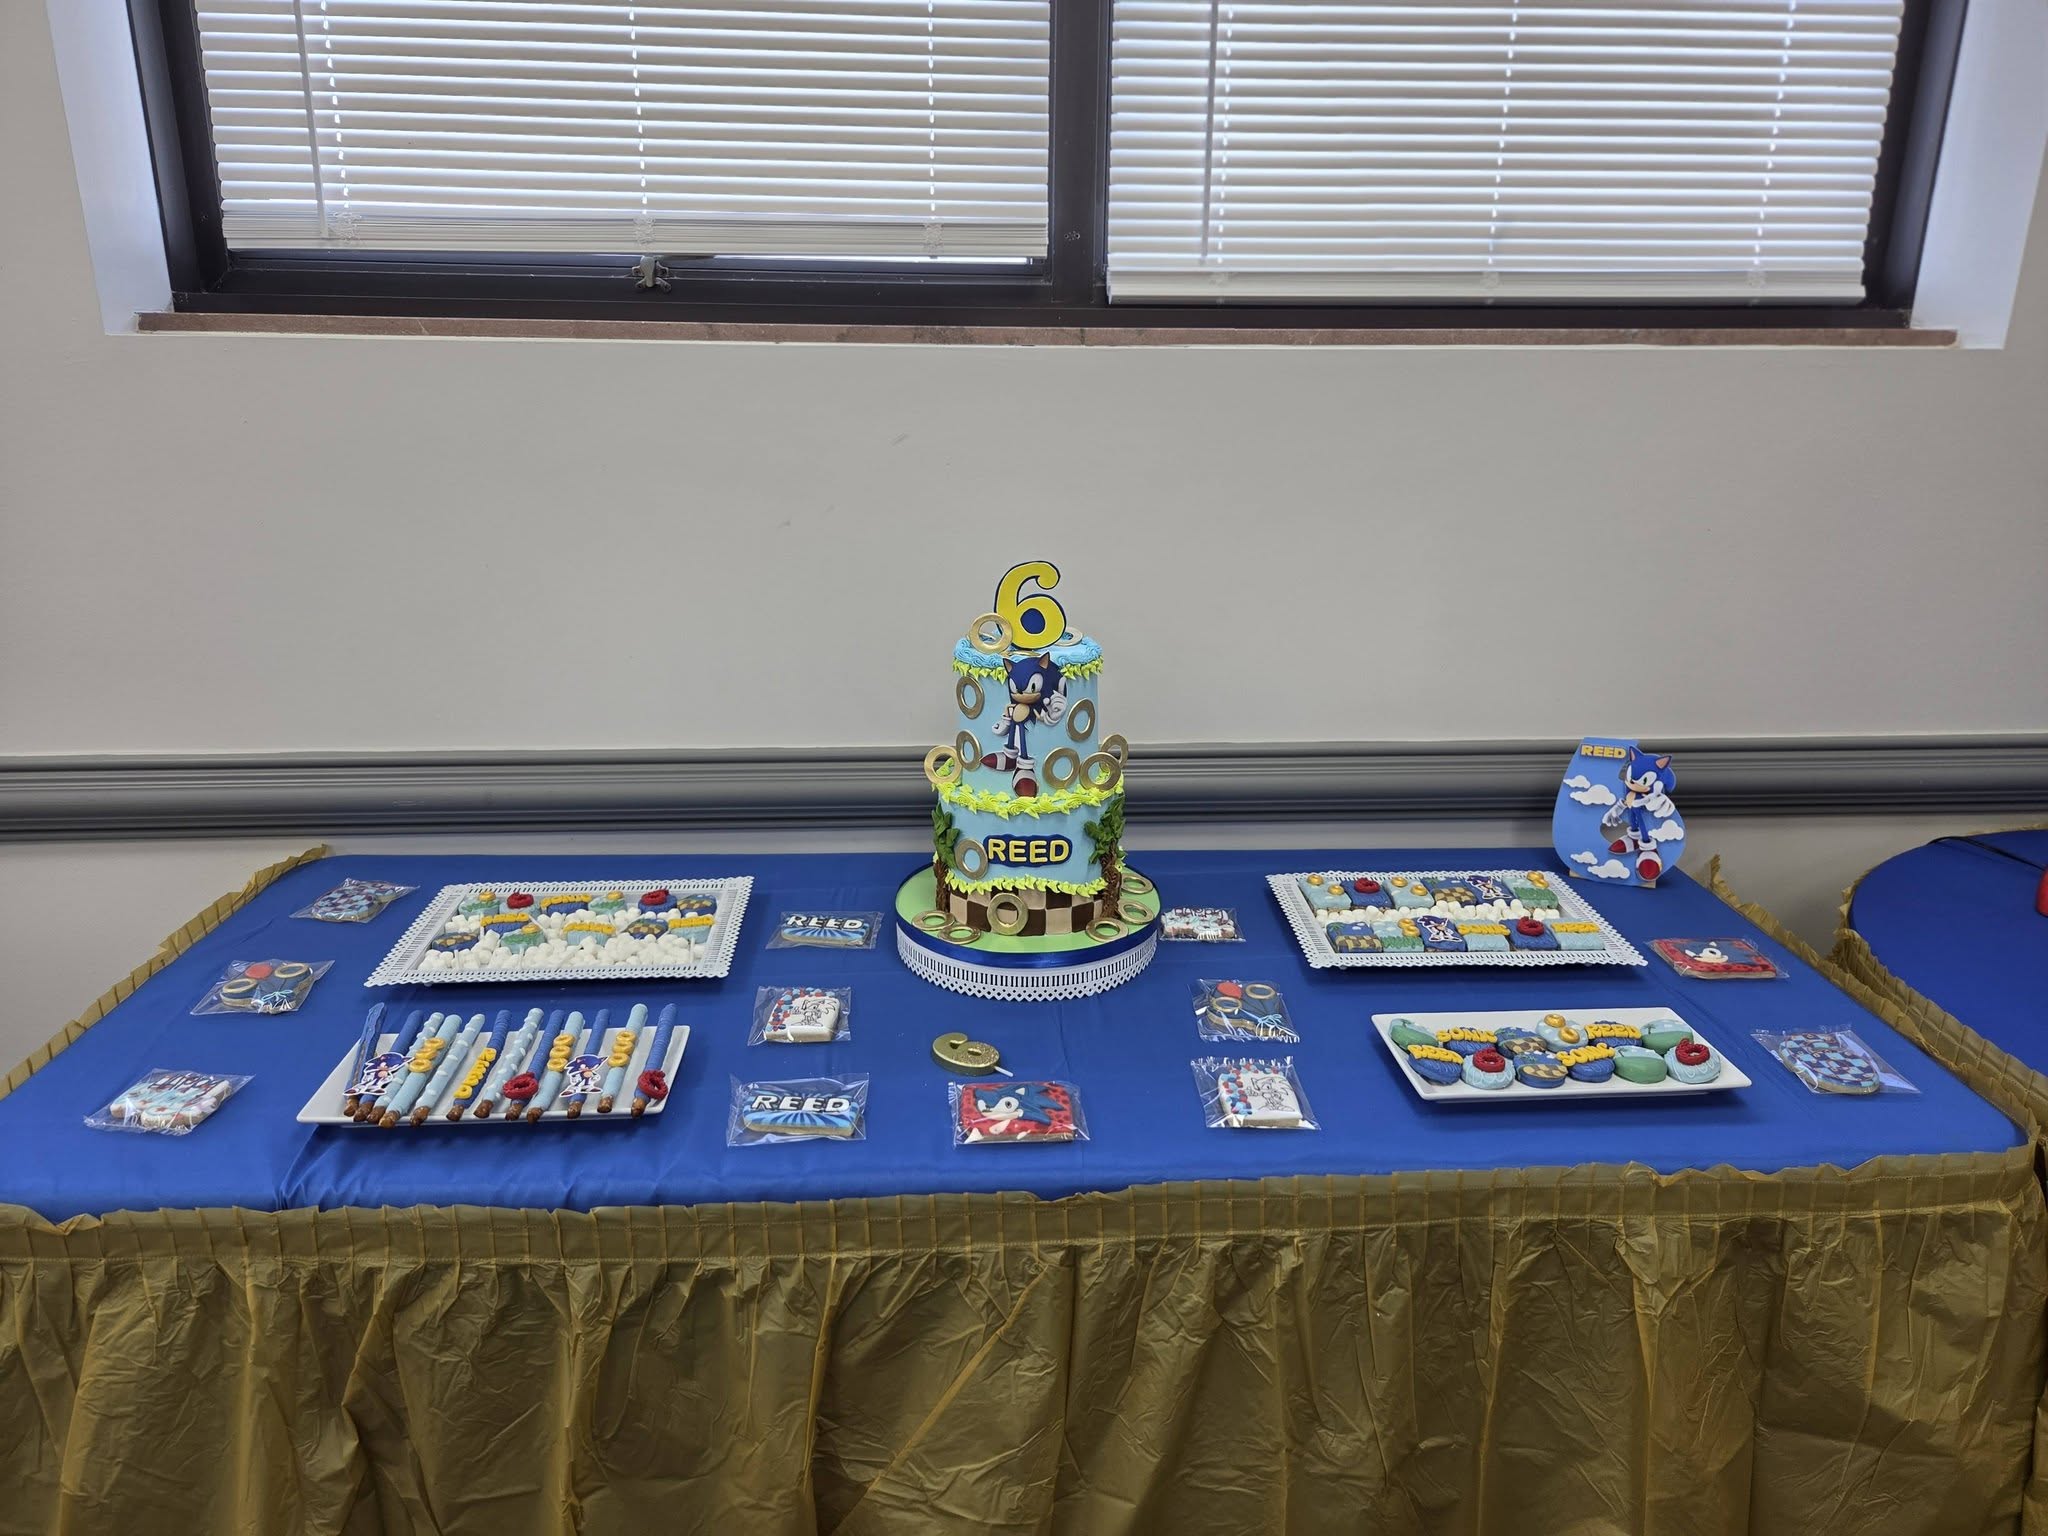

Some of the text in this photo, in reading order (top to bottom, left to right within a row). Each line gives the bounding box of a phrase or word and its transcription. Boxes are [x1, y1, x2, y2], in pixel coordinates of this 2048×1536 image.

[994, 561, 1067, 651] 6
[1580, 744, 1627, 759] REED
[987, 838, 1069, 863] REED
[786, 914, 863, 930] REED
[1436, 1027, 1498, 1044] SONIC
[1584, 1023, 1642, 1039] REED
[1407, 1044, 1464, 1064] REED
[751, 1095, 850, 1113] REED
